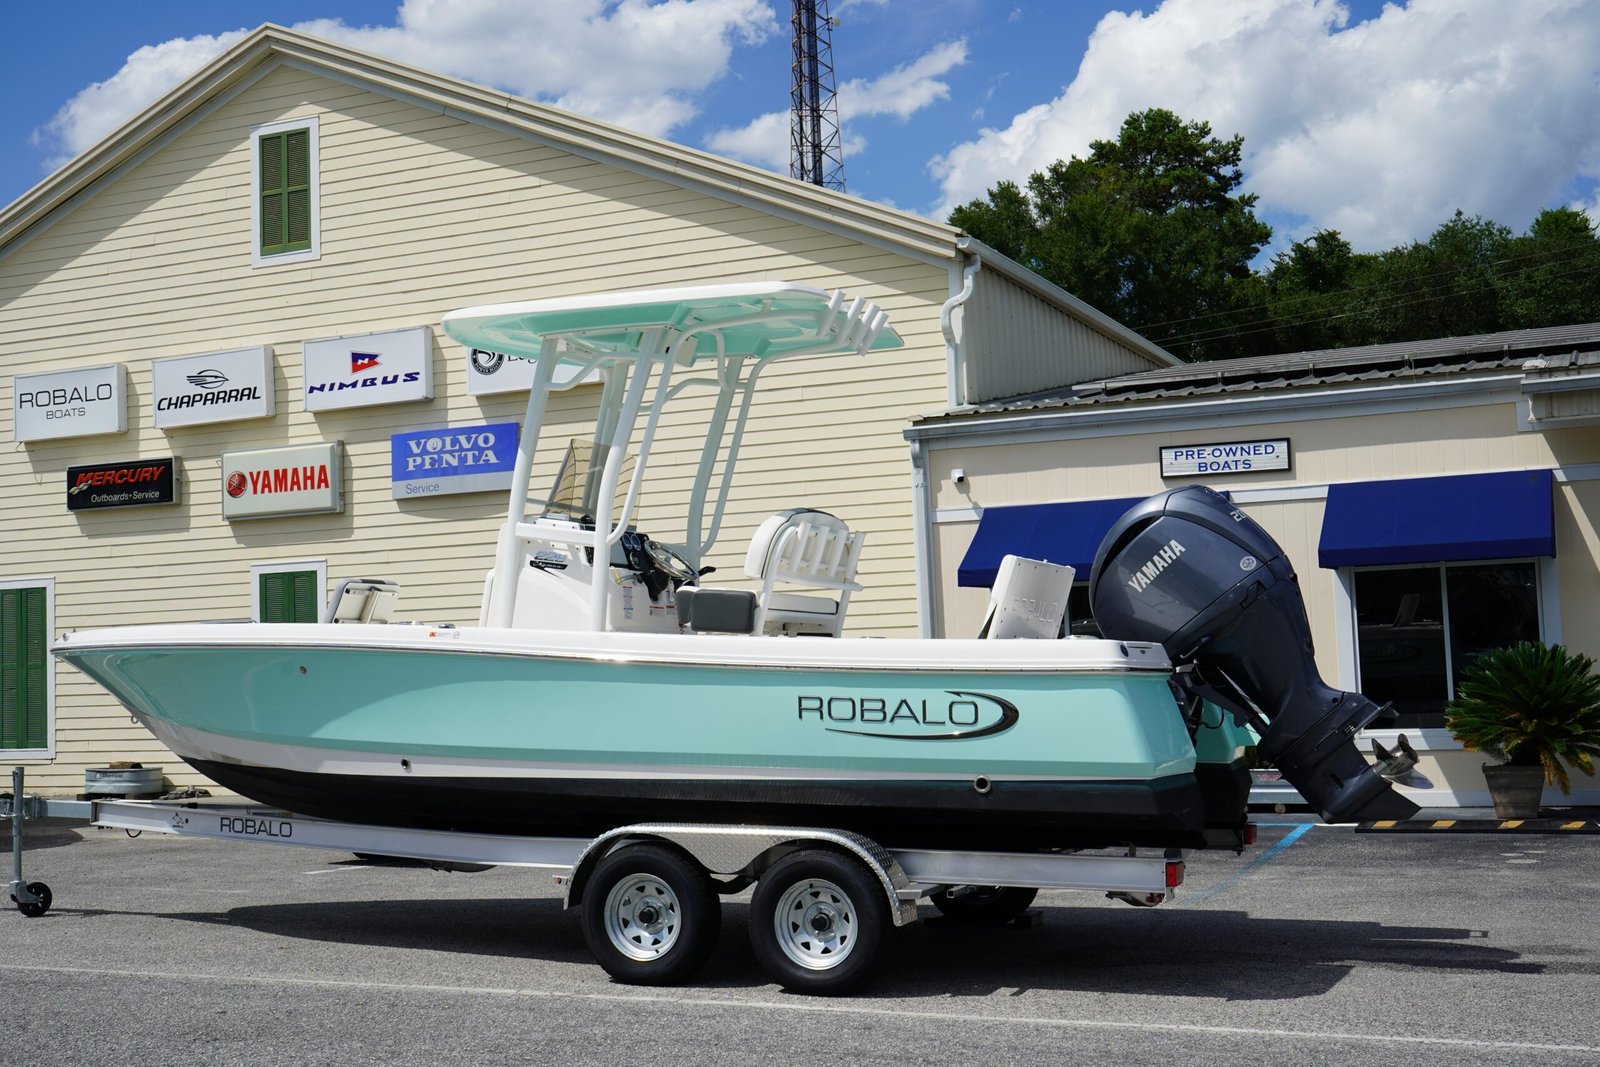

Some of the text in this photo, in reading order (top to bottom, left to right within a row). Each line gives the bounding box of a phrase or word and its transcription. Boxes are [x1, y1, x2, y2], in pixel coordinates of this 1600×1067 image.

[308, 371, 420, 394] NIMBUS
[19, 383, 112, 409] ROBALO
[157, 386, 261, 411] CHAPARRAL
[46, 407, 86, 420] BOATS
[406, 432, 495, 454] VOLVO
[1173, 444, 1275, 461] PRE-OWNED
[405, 449, 500, 472] PENTA
[1197, 459, 1252, 472] BOATS
[75, 466, 166, 488] MERCURY
[249, 464, 330, 495] YAMAHA
[405, 482, 440, 495] Service
[1128, 539, 1186, 593] YAMAHA
[797, 695, 979, 726] ROBALO
[220, 817, 293, 838] ROBALO
